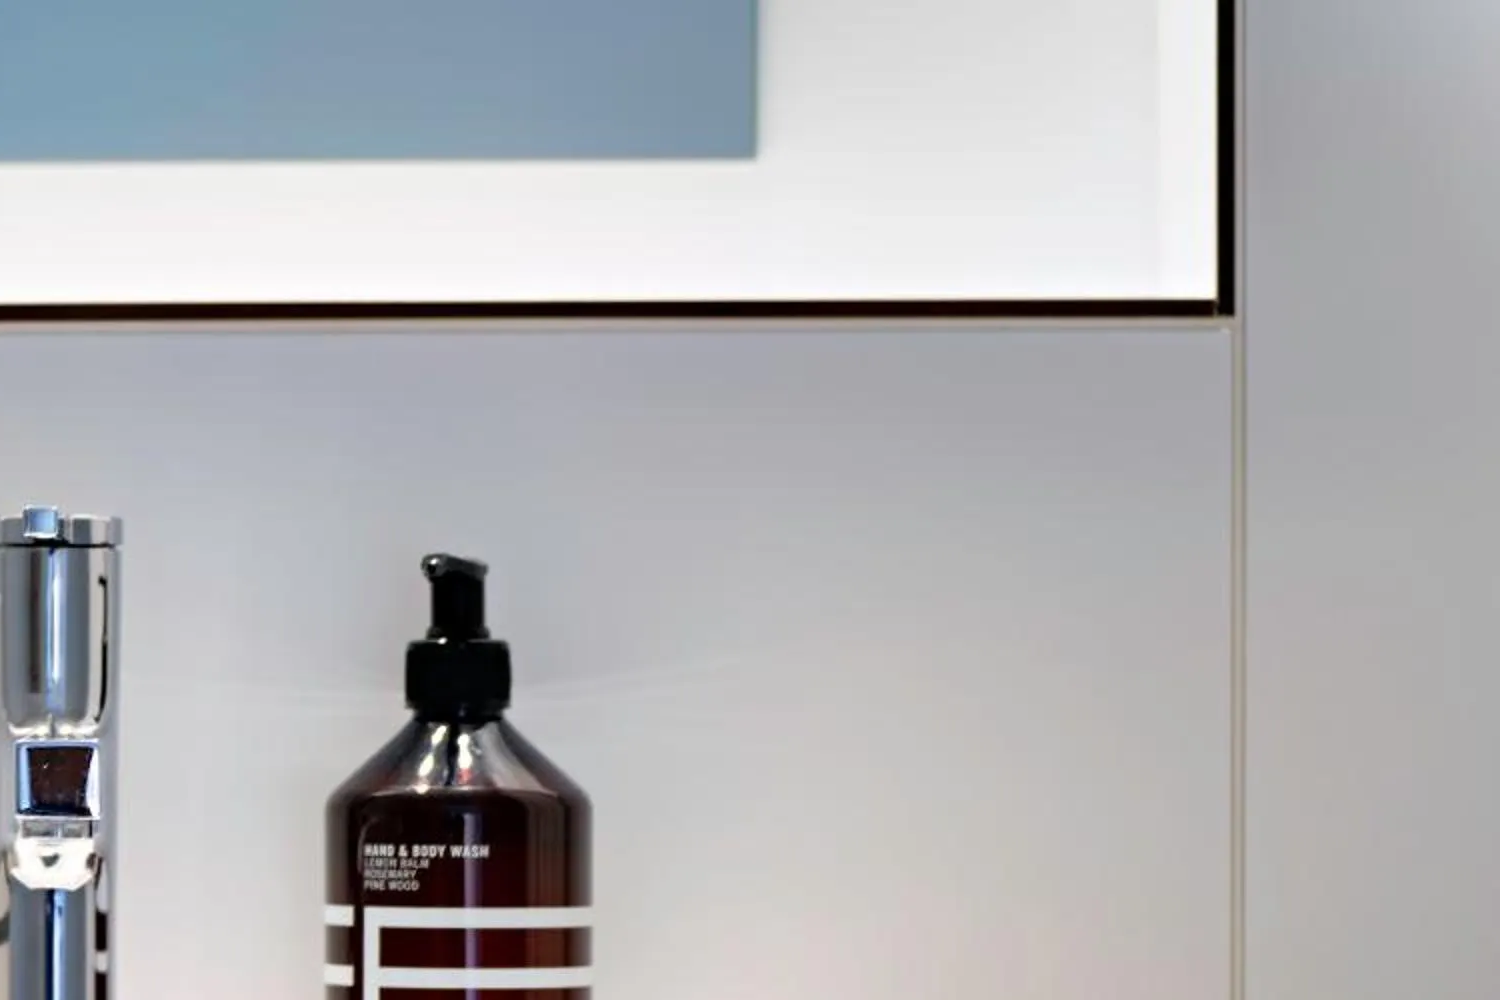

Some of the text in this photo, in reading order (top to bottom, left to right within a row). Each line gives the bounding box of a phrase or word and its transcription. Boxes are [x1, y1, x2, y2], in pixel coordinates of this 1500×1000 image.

[363, 844, 490, 858] HAND & BODY WASH
[400, 858, 430, 869] BALM
[363, 880, 420, 891] PINE WOOD
